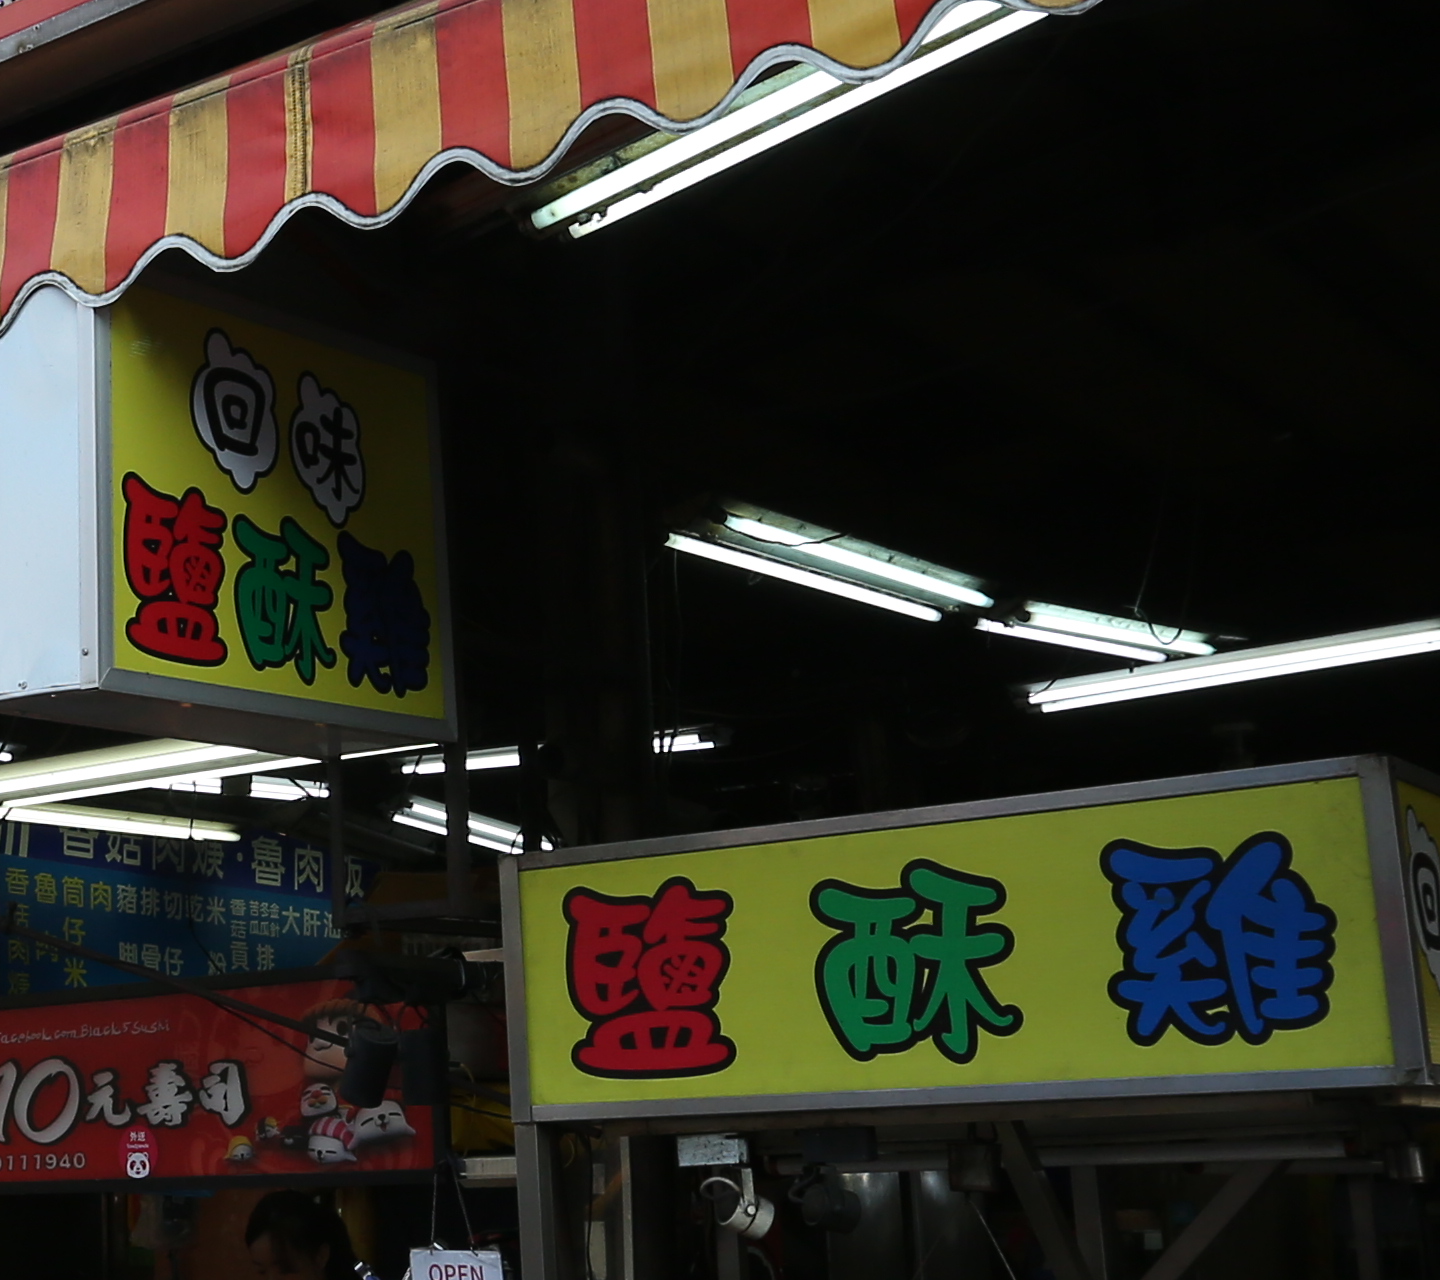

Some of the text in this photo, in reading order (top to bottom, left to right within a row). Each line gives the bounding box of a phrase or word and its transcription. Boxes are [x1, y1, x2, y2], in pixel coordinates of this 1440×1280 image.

[204, 367, 360, 500] 回味
[122, 472, 430, 697] 鹽酥雞
[563, 830, 1336, 1081] 鹽酥雞
